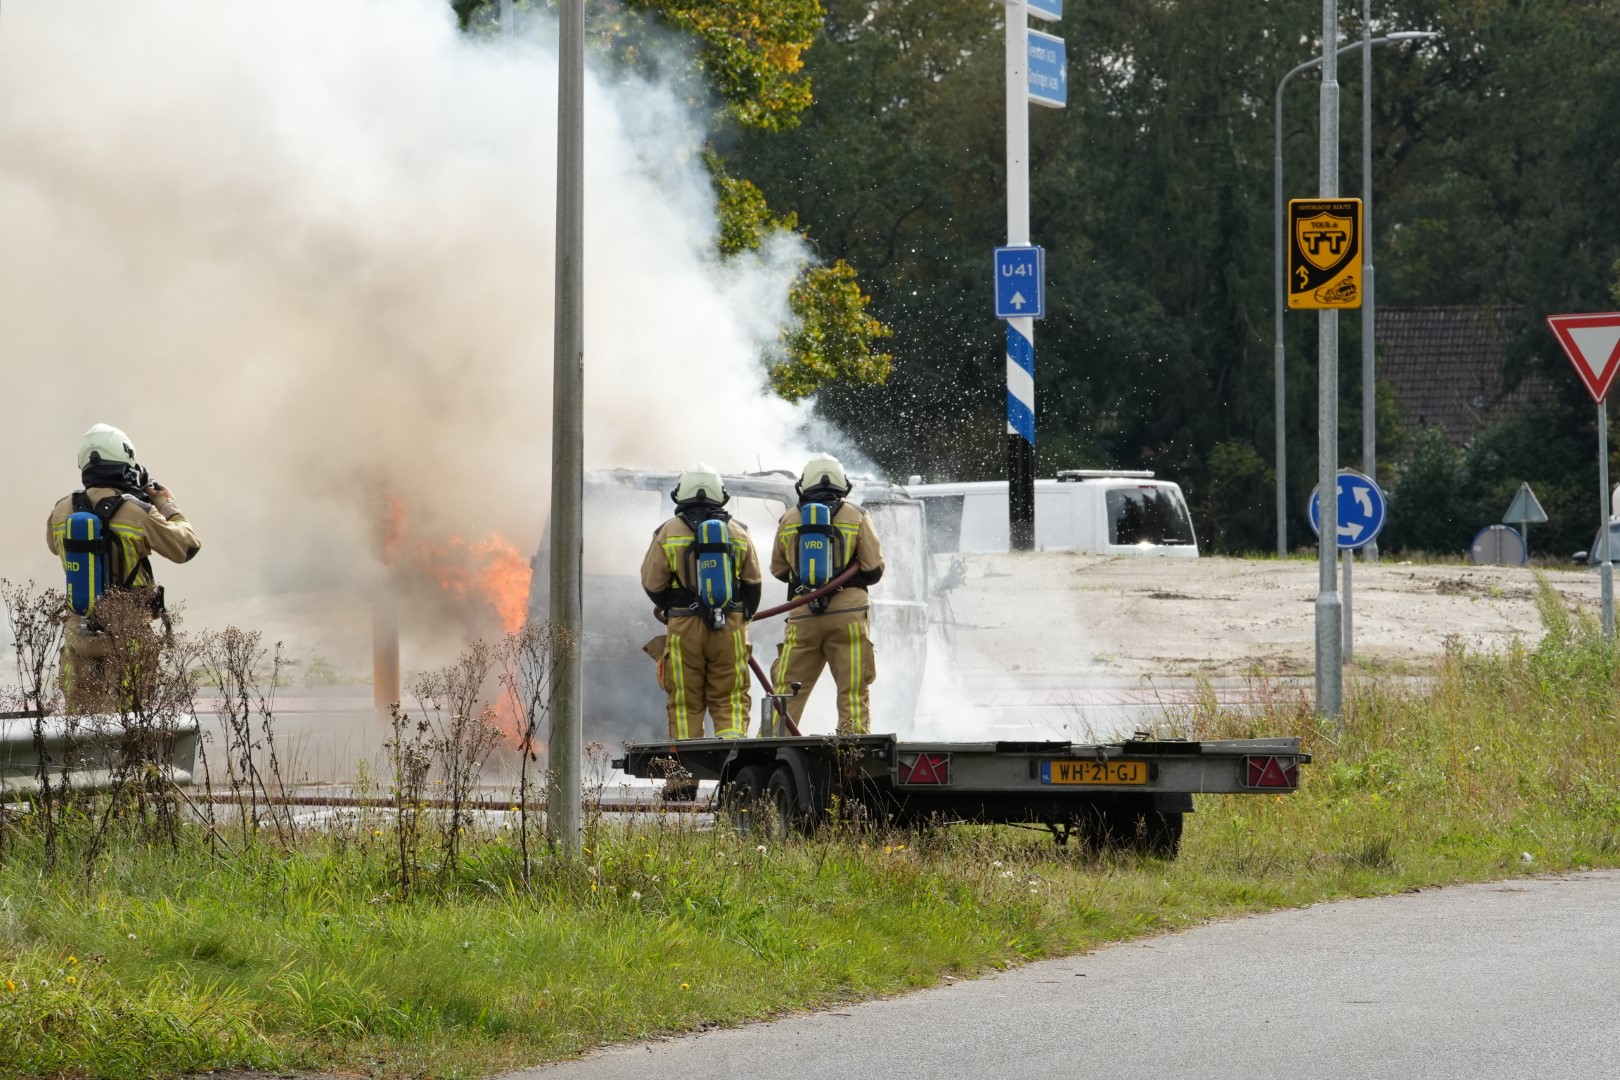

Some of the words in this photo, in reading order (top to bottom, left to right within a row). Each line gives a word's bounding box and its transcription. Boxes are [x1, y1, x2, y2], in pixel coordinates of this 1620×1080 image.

[1311, 221, 1331, 229] TOUR
[1303, 231, 1347, 255] TT
[1002, 263, 1033, 277] U41
[804, 541, 823, 550] VRD
[66, 561, 80, 571] RD
[700, 559, 717, 569] VRD
[1059, 764, 1138, 781] WH-21-GJ
